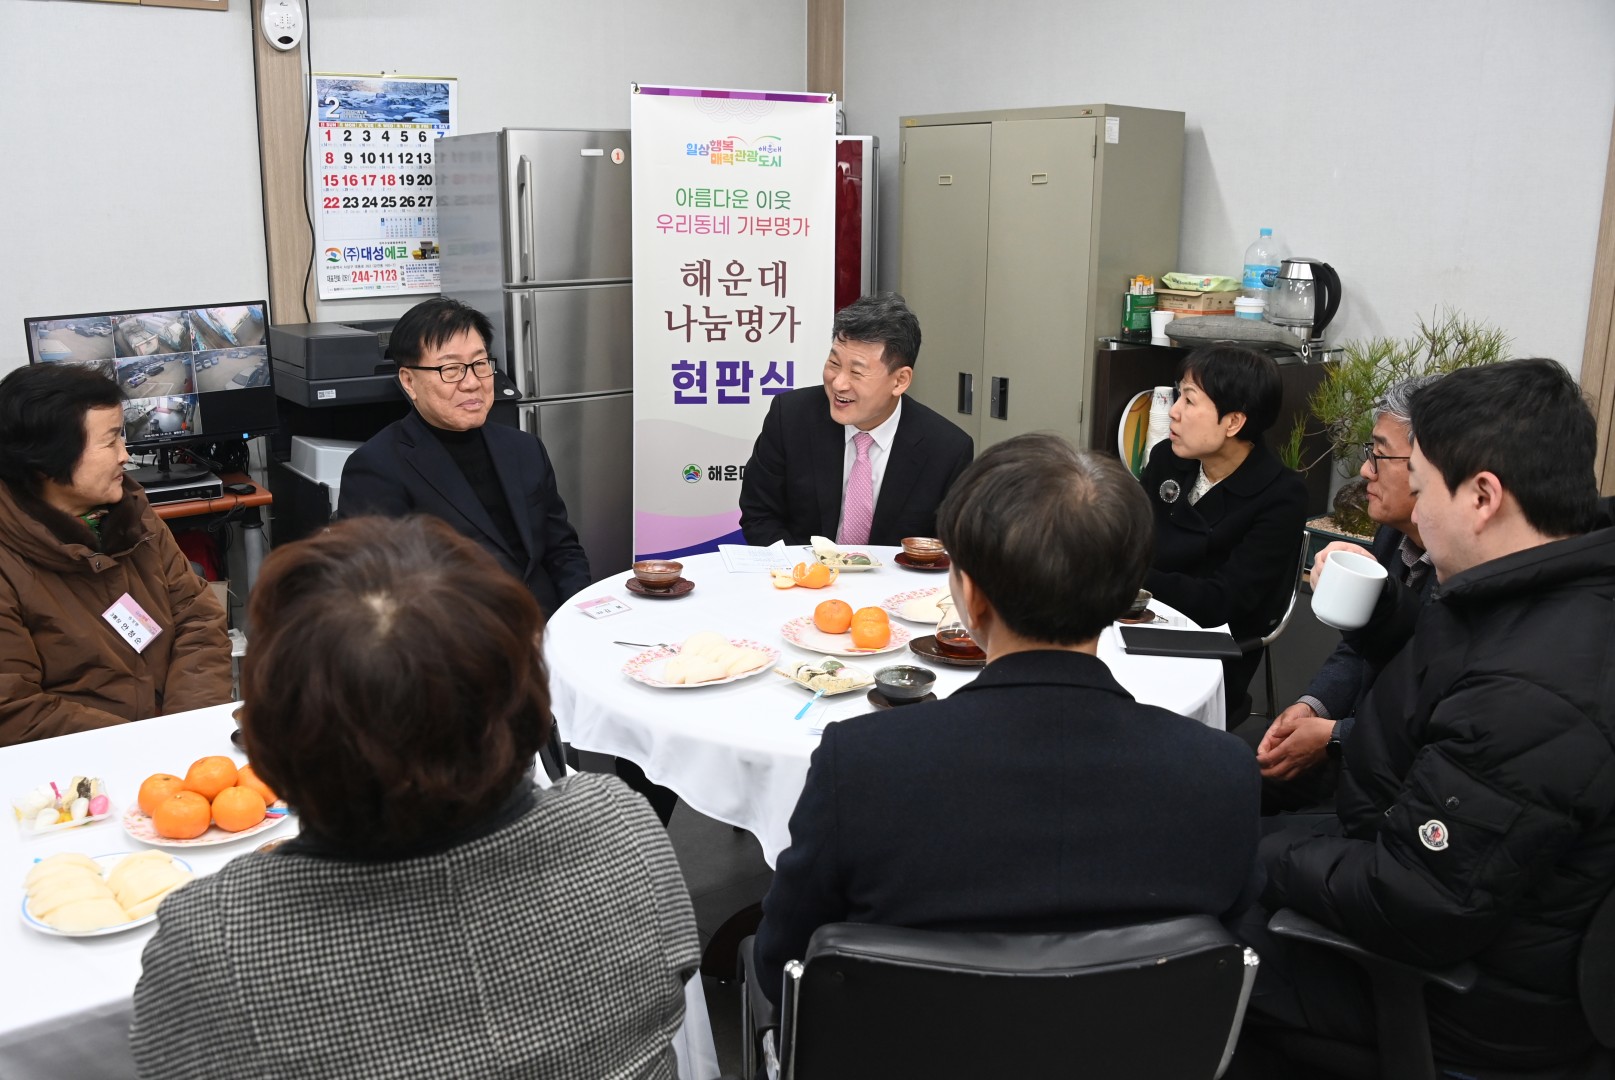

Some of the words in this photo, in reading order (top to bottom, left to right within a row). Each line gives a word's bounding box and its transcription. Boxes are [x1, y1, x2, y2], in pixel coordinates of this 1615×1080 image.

[325, 96, 340, 118] 2
[325, 130, 331, 141] 1
[344, 130, 352, 142] 2
[362, 130, 371, 142] 3
[382, 130, 390, 142] 4
[400, 130, 408, 142] 5
[418, 131, 427, 142] 6
[686, 143, 710, 156] 일상
[710, 140, 734, 152] 행복
[325, 152, 334, 164] 8
[344, 152, 353, 164] 9
[360, 152, 376, 164] 10
[380, 152, 393, 164] 11
[398, 153, 413, 164] 12
[417, 153, 432, 164] 13
[710, 153, 734, 165] 매력
[735, 149, 758, 162] 관광
[758, 155, 782, 168] 도시
[323, 174, 339, 186] 15
[342, 174, 358, 186] 16
[361, 174, 377, 186] 17
[380, 174, 396, 186] 18
[399, 174, 414, 186] 19
[417, 174, 433, 186] 20
[323, 197, 340, 209] 22
[343, 197, 359, 208] 23
[362, 196, 378, 208] 24
[381, 196, 397, 207] 25
[400, 196, 416, 207] 26
[418, 196, 433, 207] 27
[676, 187, 749, 209] 아름다운
[756, 190, 792, 210] 이웃
[656, 214, 730, 235] 우리동네
[737, 215, 810, 237] 기부명가
[344, 245, 408, 262] (주)대성에코
[352, 270, 398, 283] 244-7123
[680, 258, 787, 298] 해운대
[664, 304, 801, 344] 나눔명가
[672, 360, 794, 404] 현판식
